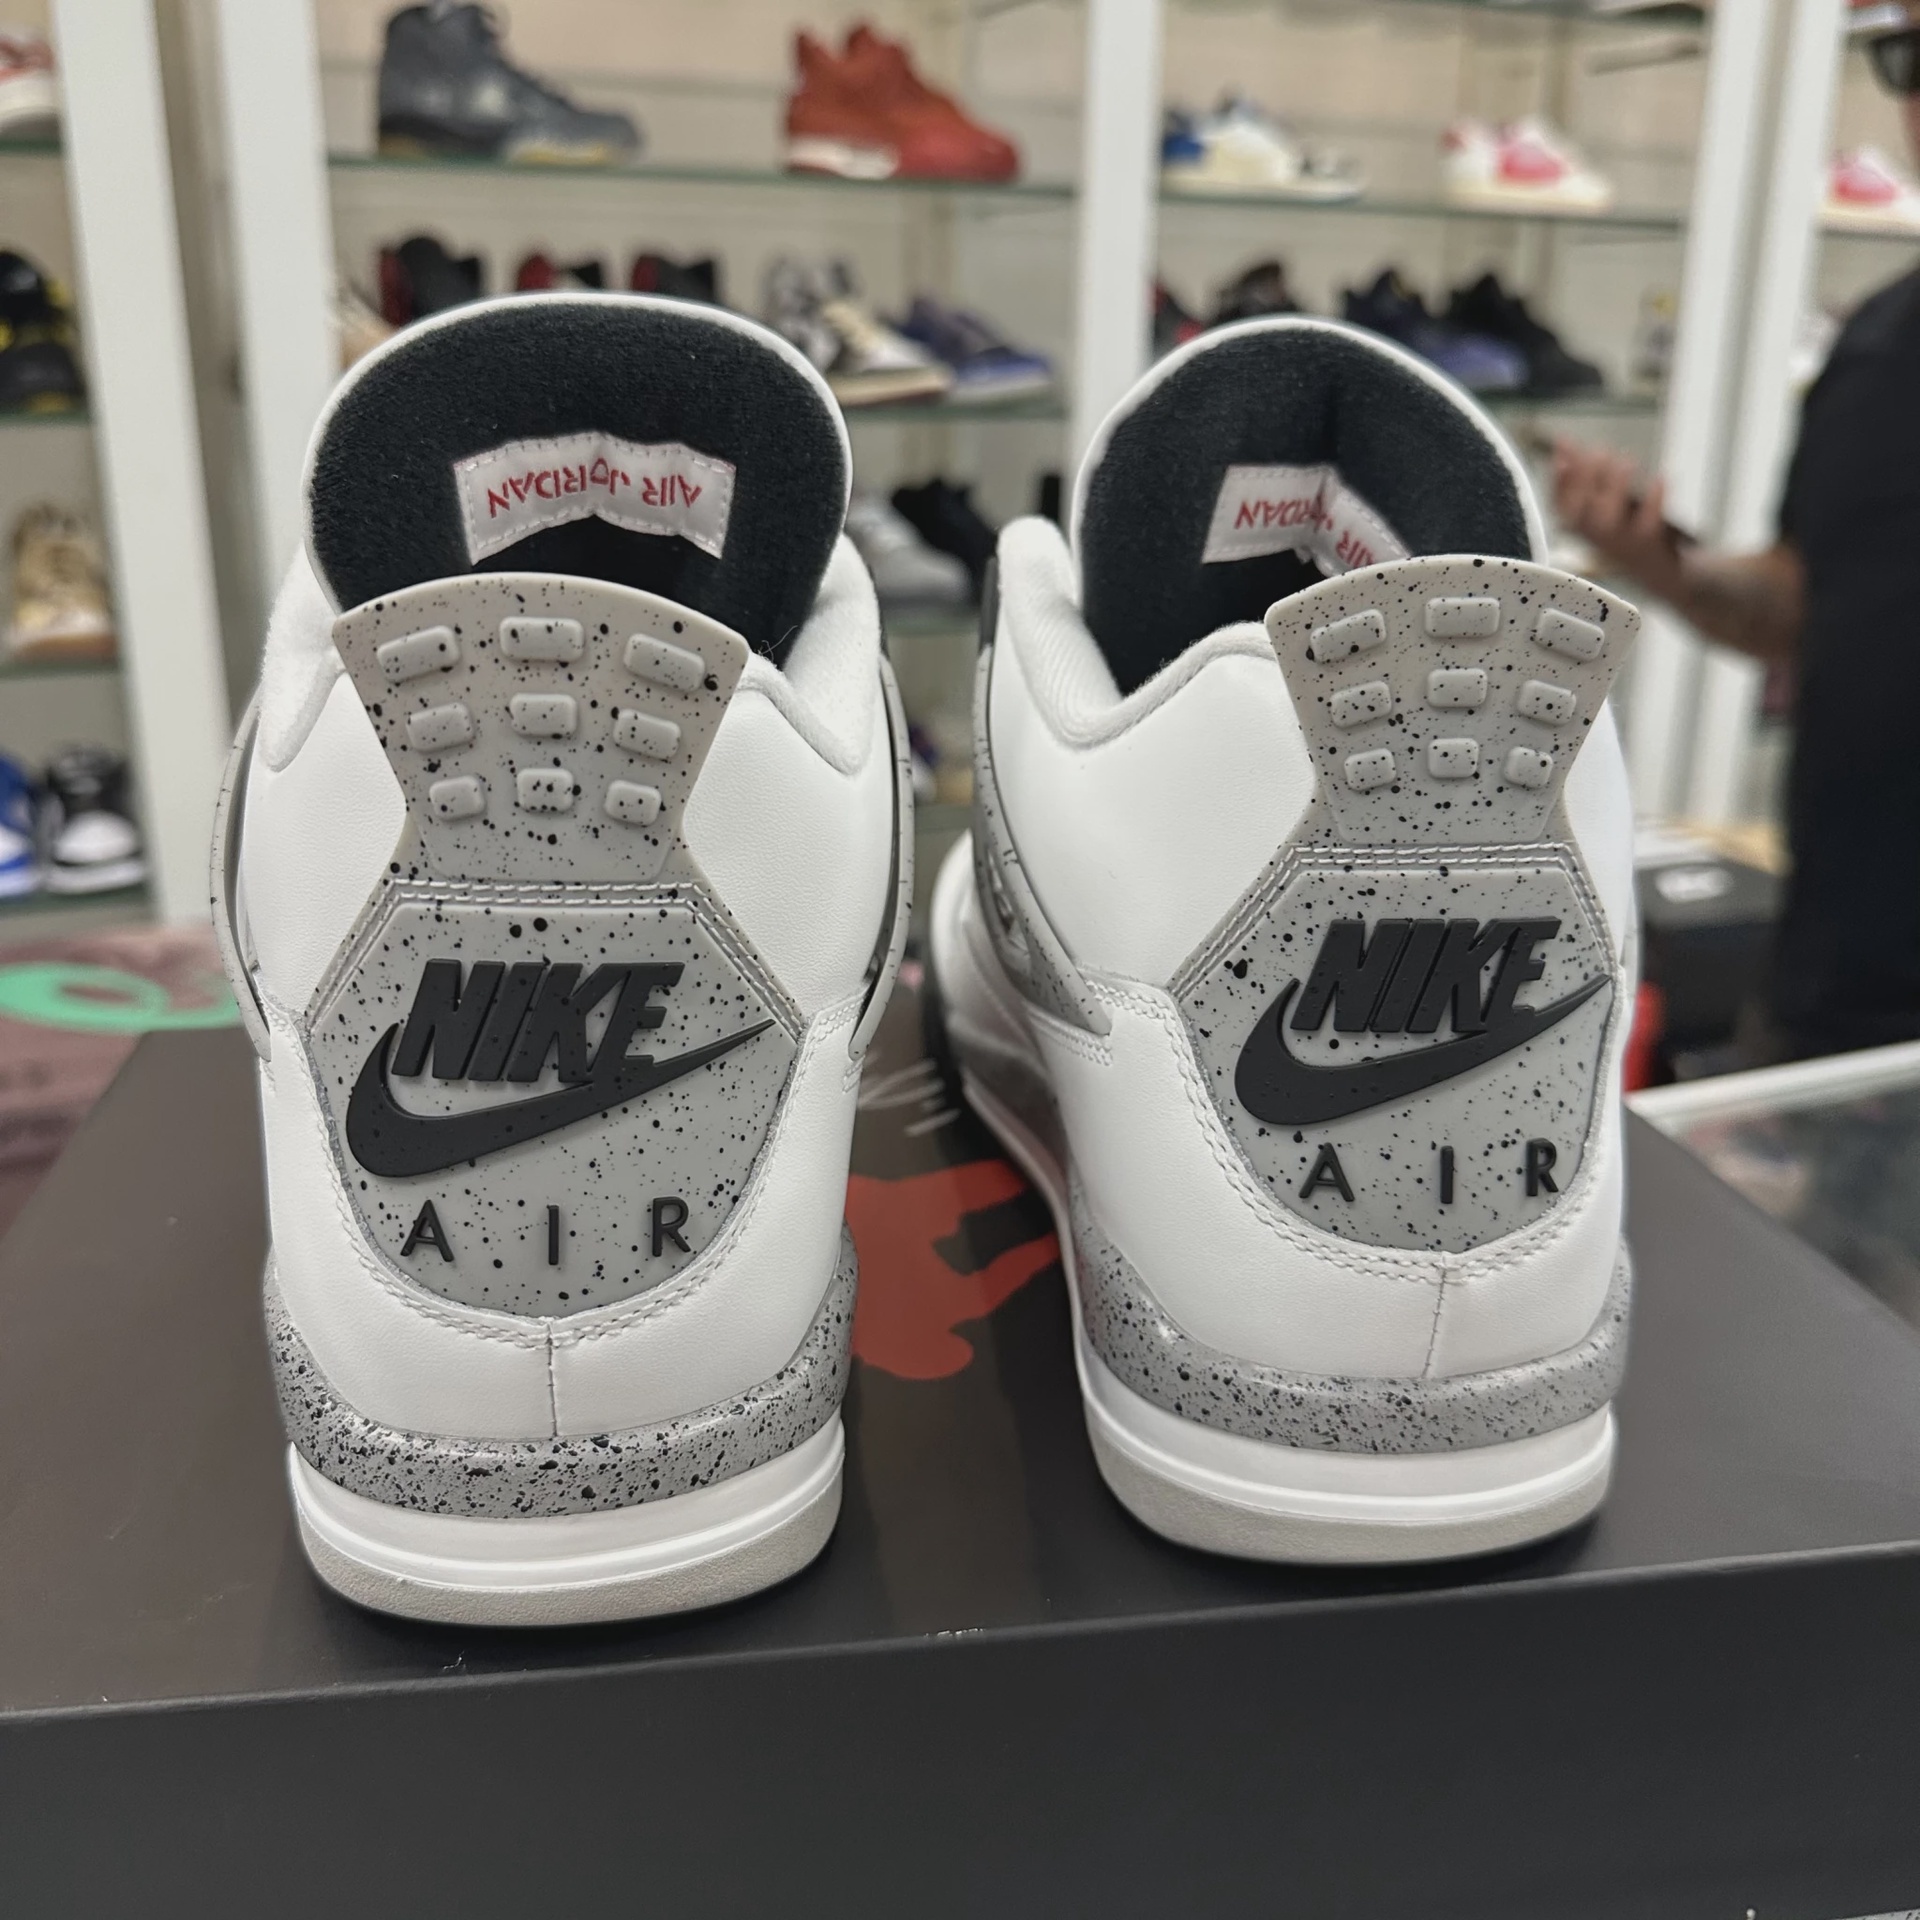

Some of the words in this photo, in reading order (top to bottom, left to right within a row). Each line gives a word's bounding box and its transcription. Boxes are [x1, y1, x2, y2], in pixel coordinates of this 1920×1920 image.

[487, 457, 631, 518] JORDAN
[641, 474, 703, 508] AIR
[1290, 915, 1562, 1034] NIKE
[391, 957, 686, 1083] NIKE
[1299, 1137, 1559, 1204] AIR
[400, 1196, 692, 1266] AIR
